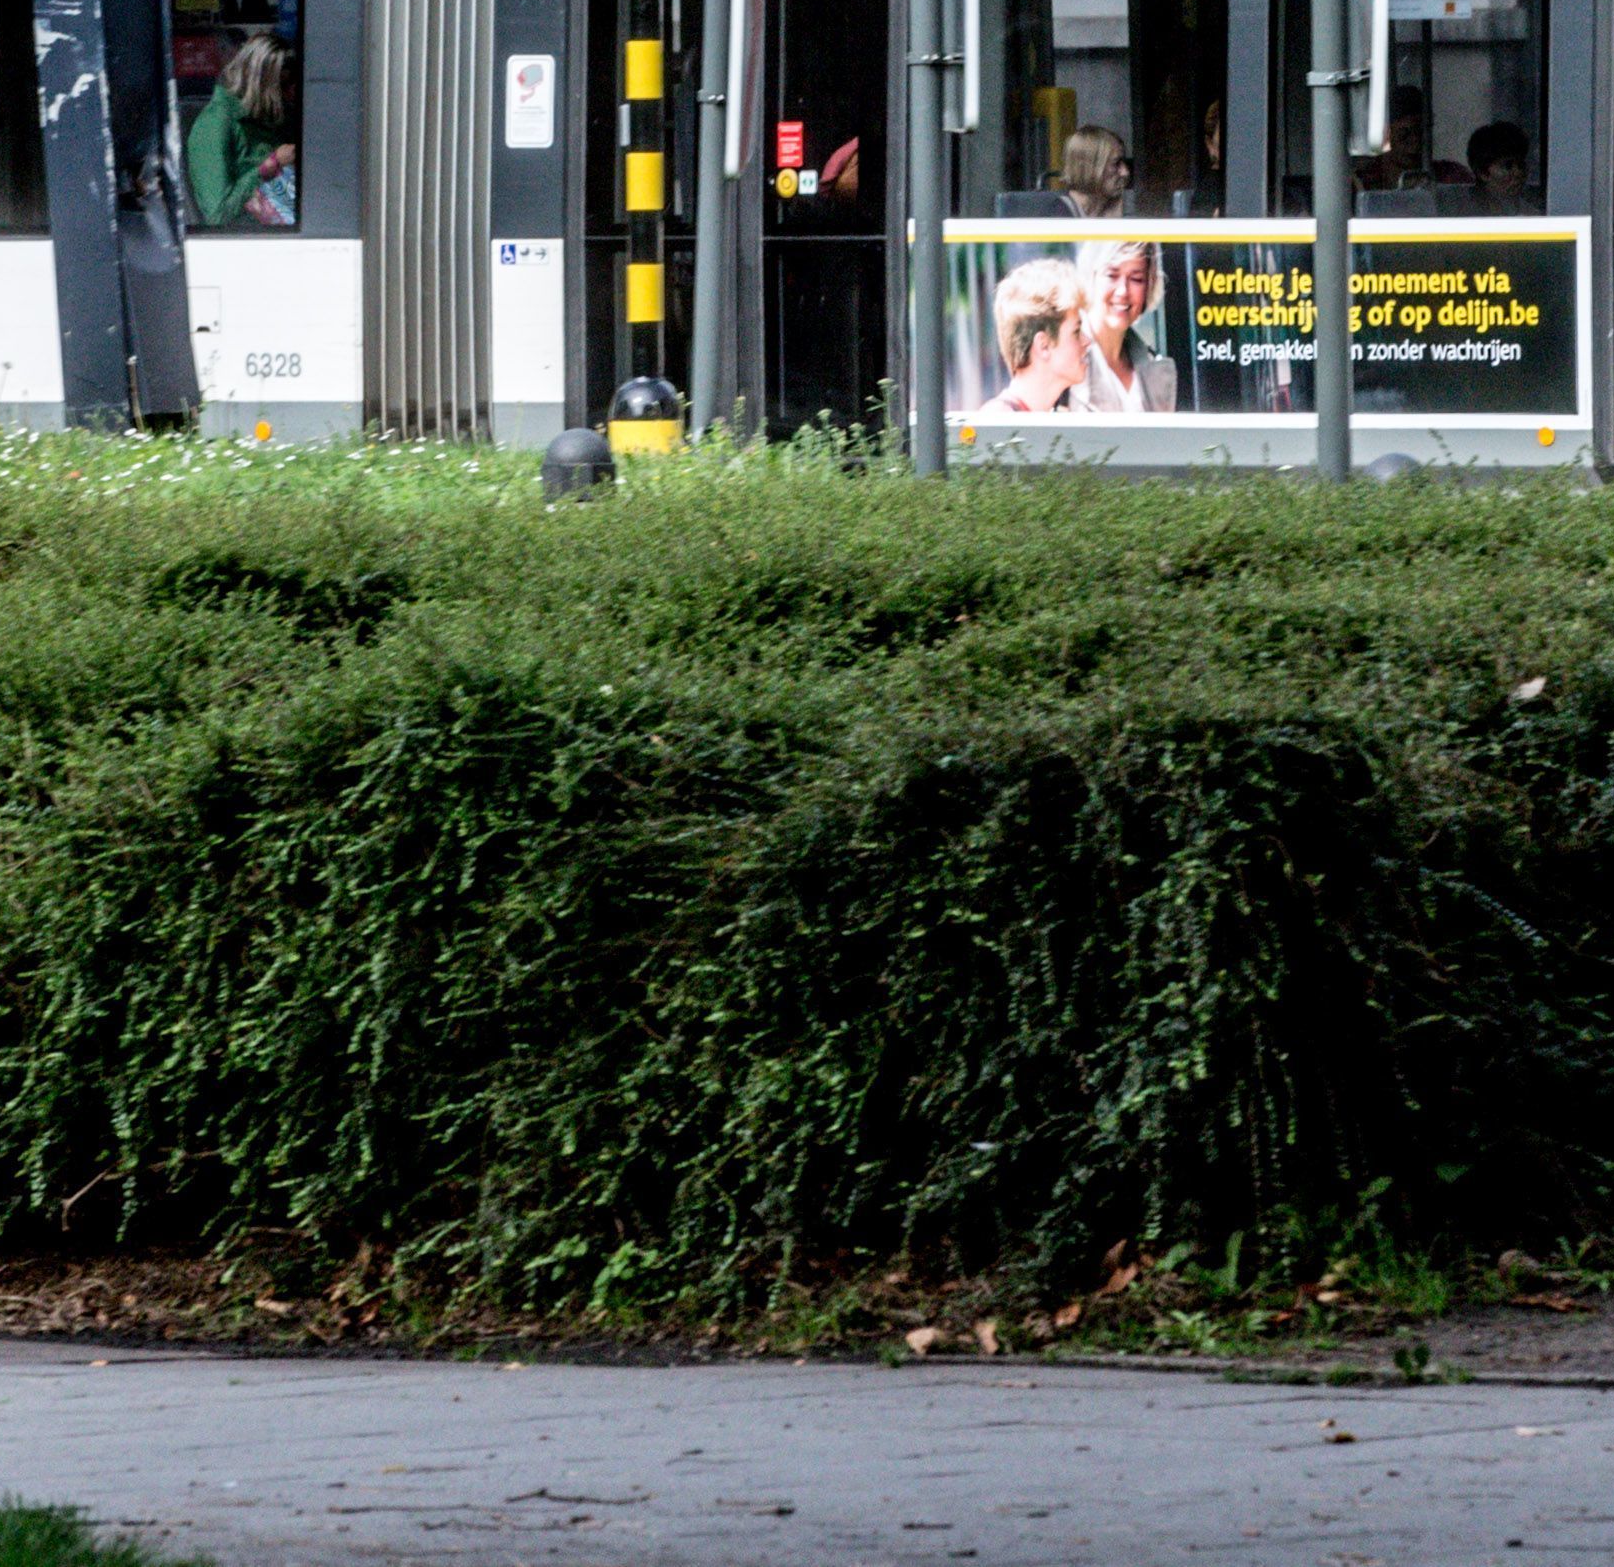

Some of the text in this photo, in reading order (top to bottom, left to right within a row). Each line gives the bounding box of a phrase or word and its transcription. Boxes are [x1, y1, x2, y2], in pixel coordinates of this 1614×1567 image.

[1195, 265, 1512, 301] Verleng je onnement via
[1196, 298, 1540, 334] overschrijg of op delijn.be
[245, 352, 302, 379] 6328
[1196, 338, 1237, 363] Snel,
[1239, 338, 1319, 367] gemakkel
[1366, 338, 1427, 362] zonder
[1430, 338, 1522, 367] wachtrijen
